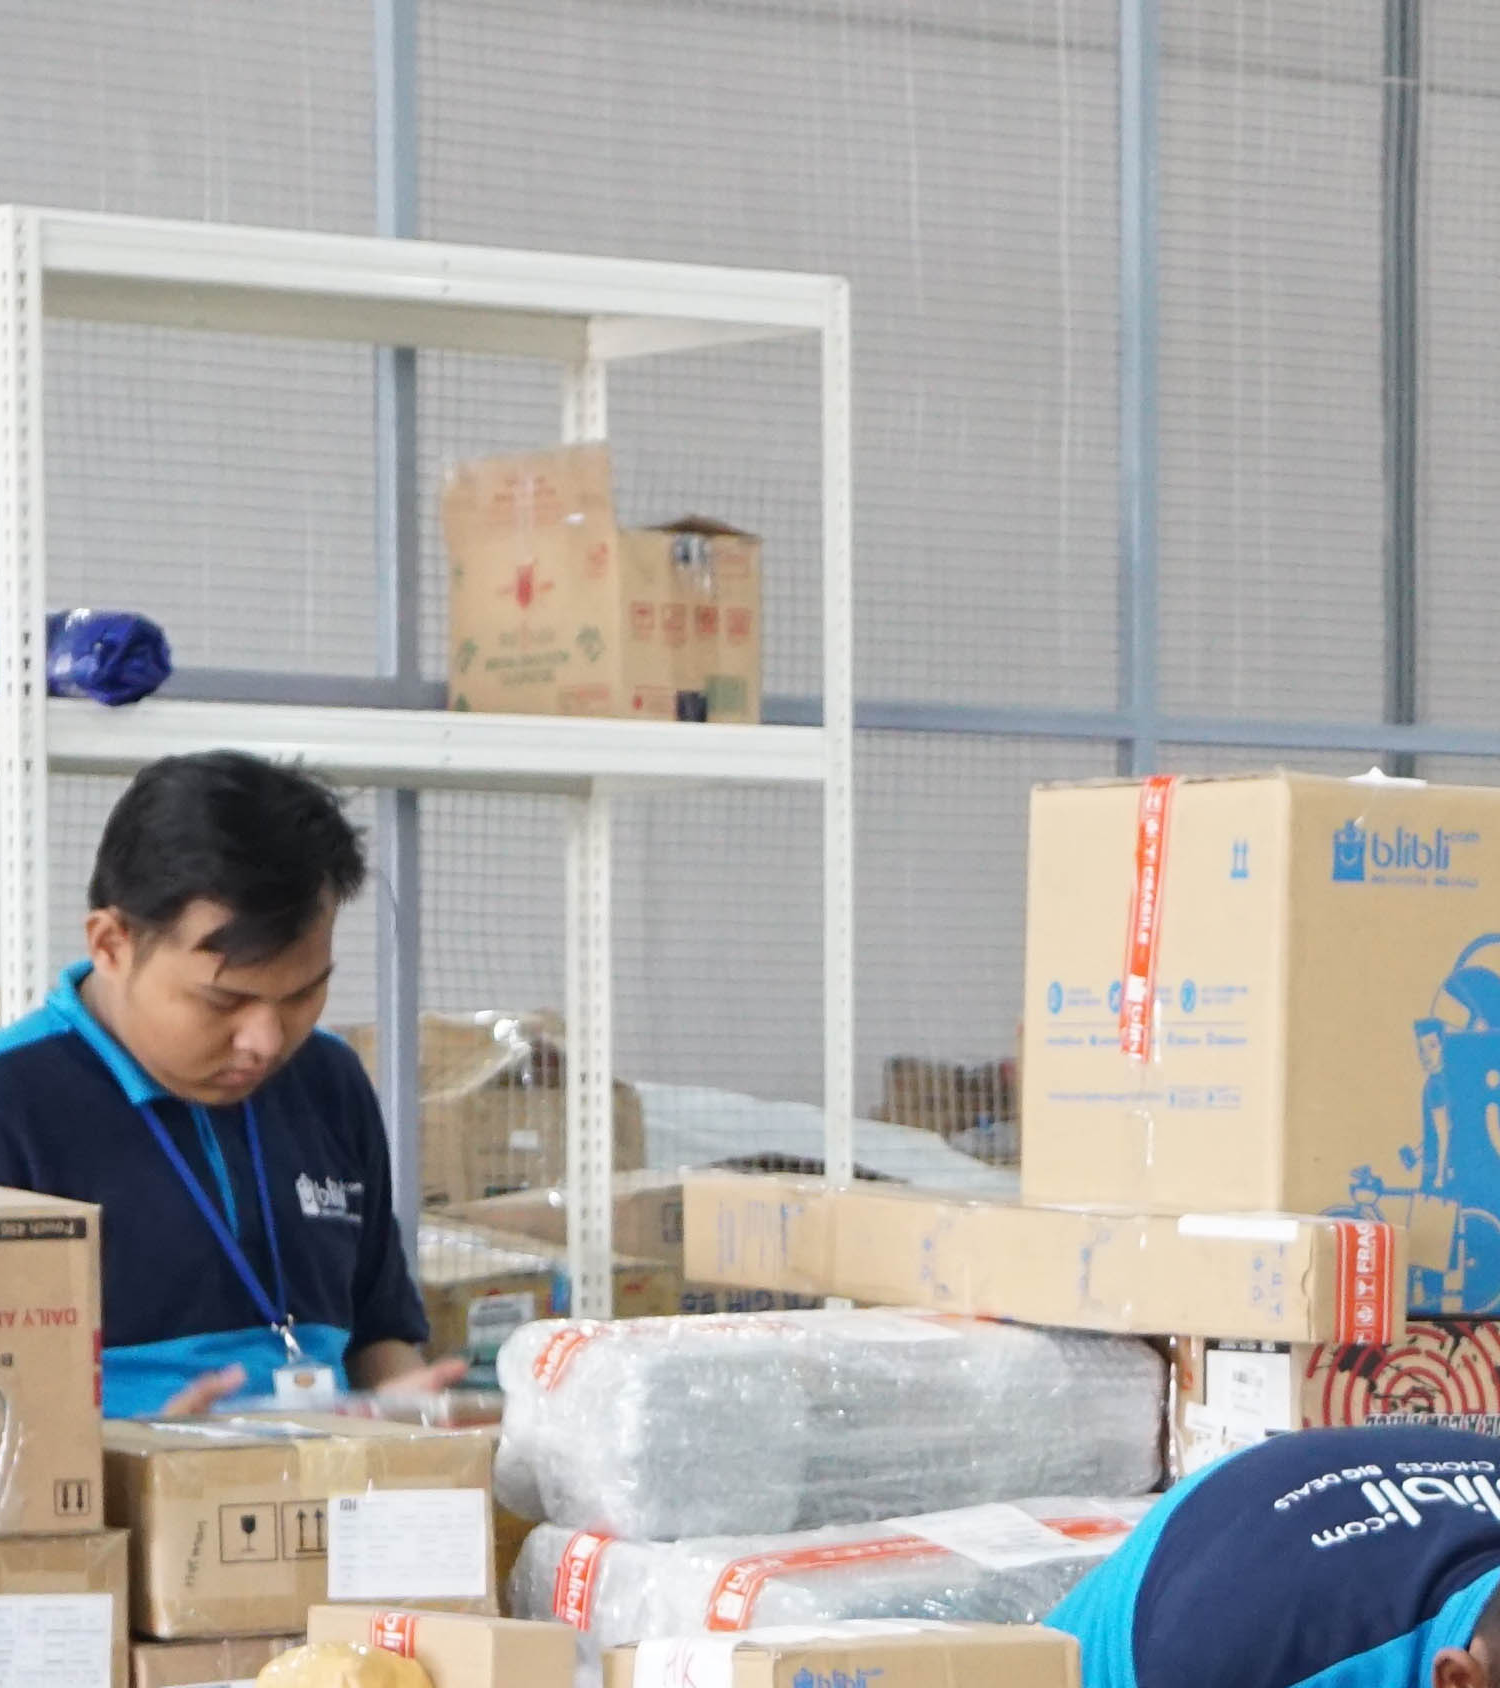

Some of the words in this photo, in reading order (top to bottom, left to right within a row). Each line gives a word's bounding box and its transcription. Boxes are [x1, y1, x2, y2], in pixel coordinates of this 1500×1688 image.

[23, 1307, 78, 1328] DAILY
[1273, 1471, 1341, 1512] DEALS
[1341, 1463, 1383, 1481] BIG
[1396, 1460, 1495, 1475] CHOICES
